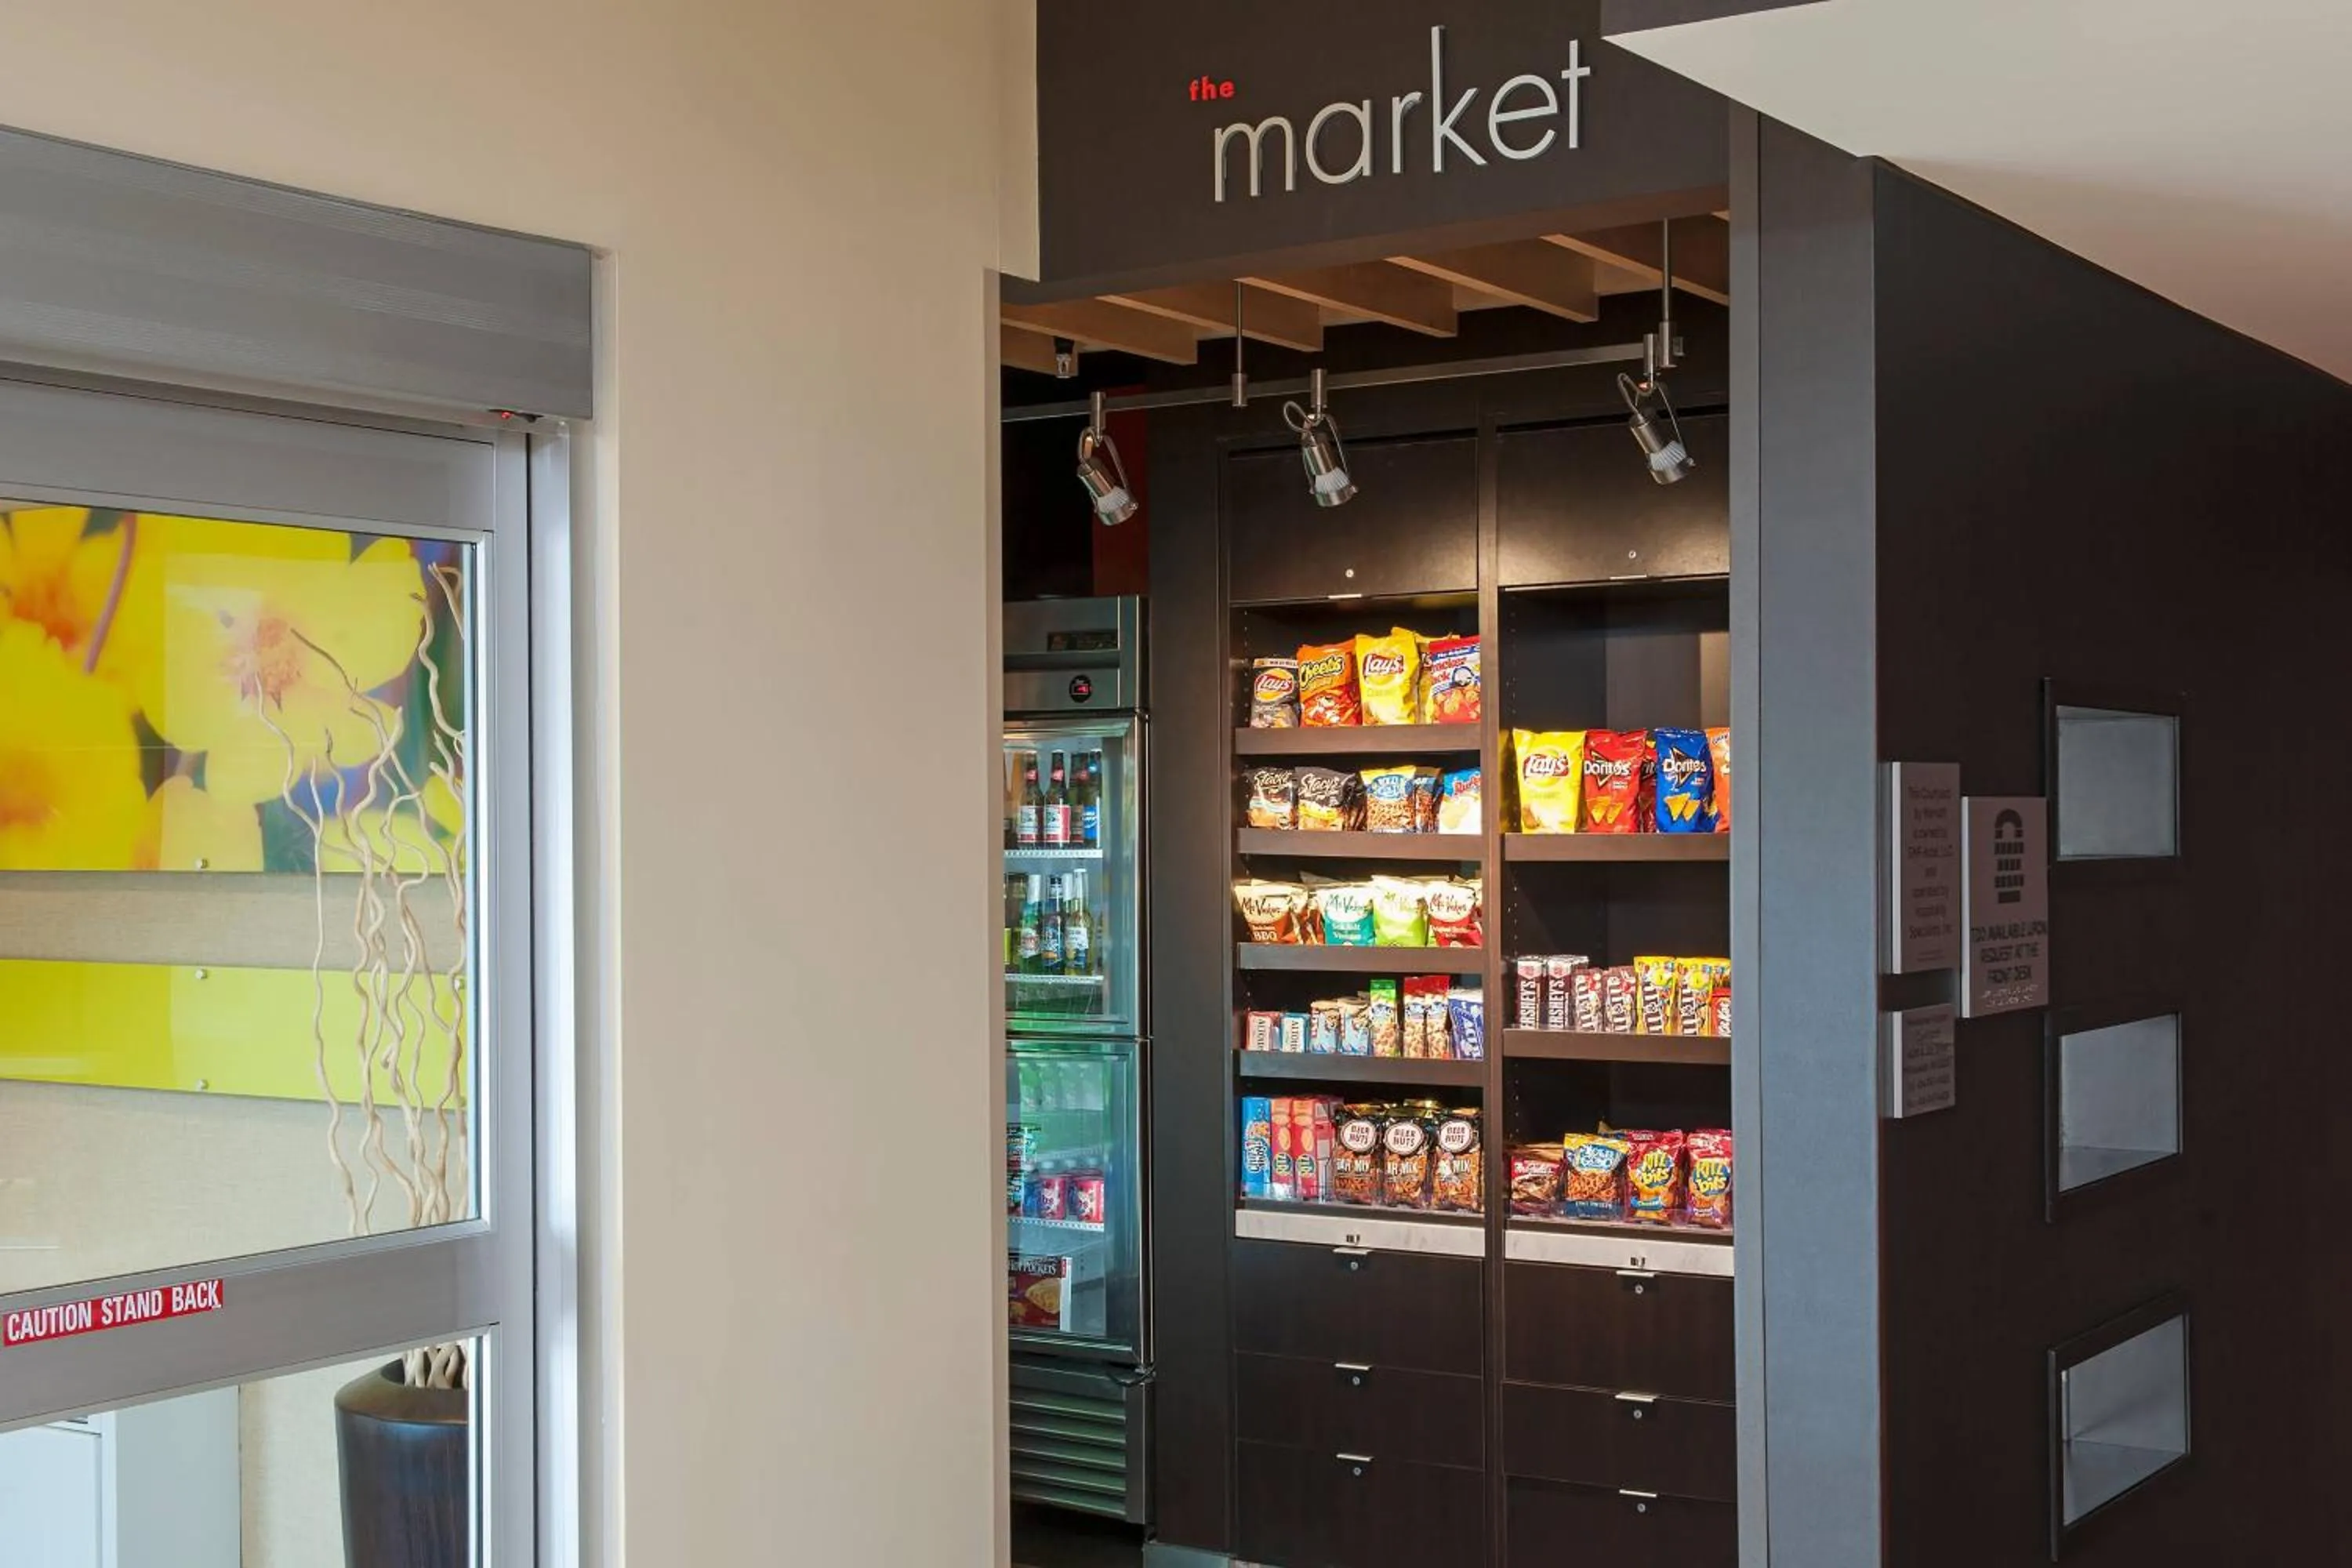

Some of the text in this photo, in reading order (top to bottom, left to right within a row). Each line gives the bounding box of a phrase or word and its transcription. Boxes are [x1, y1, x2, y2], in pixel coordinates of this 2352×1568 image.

[1189, 76, 1236, 101] the
[1214, 25, 1591, 202] market
[1584, 760, 1632, 776] Doritos
[1663, 757, 1707, 773] Doritos
[1520, 980, 1536, 1029] ERSHEY'S
[1549, 979, 1565, 1029] ERSHEY'S
[1348, 1133, 1368, 1144] NUTS
[1393, 1136, 1415, 1147] NUTS
[1445, 1134, 1465, 1144] NUTS
[1696, 1159, 1726, 1178] RITZ
[8, 1280, 222, 1341] CAUTION STAND BACK
